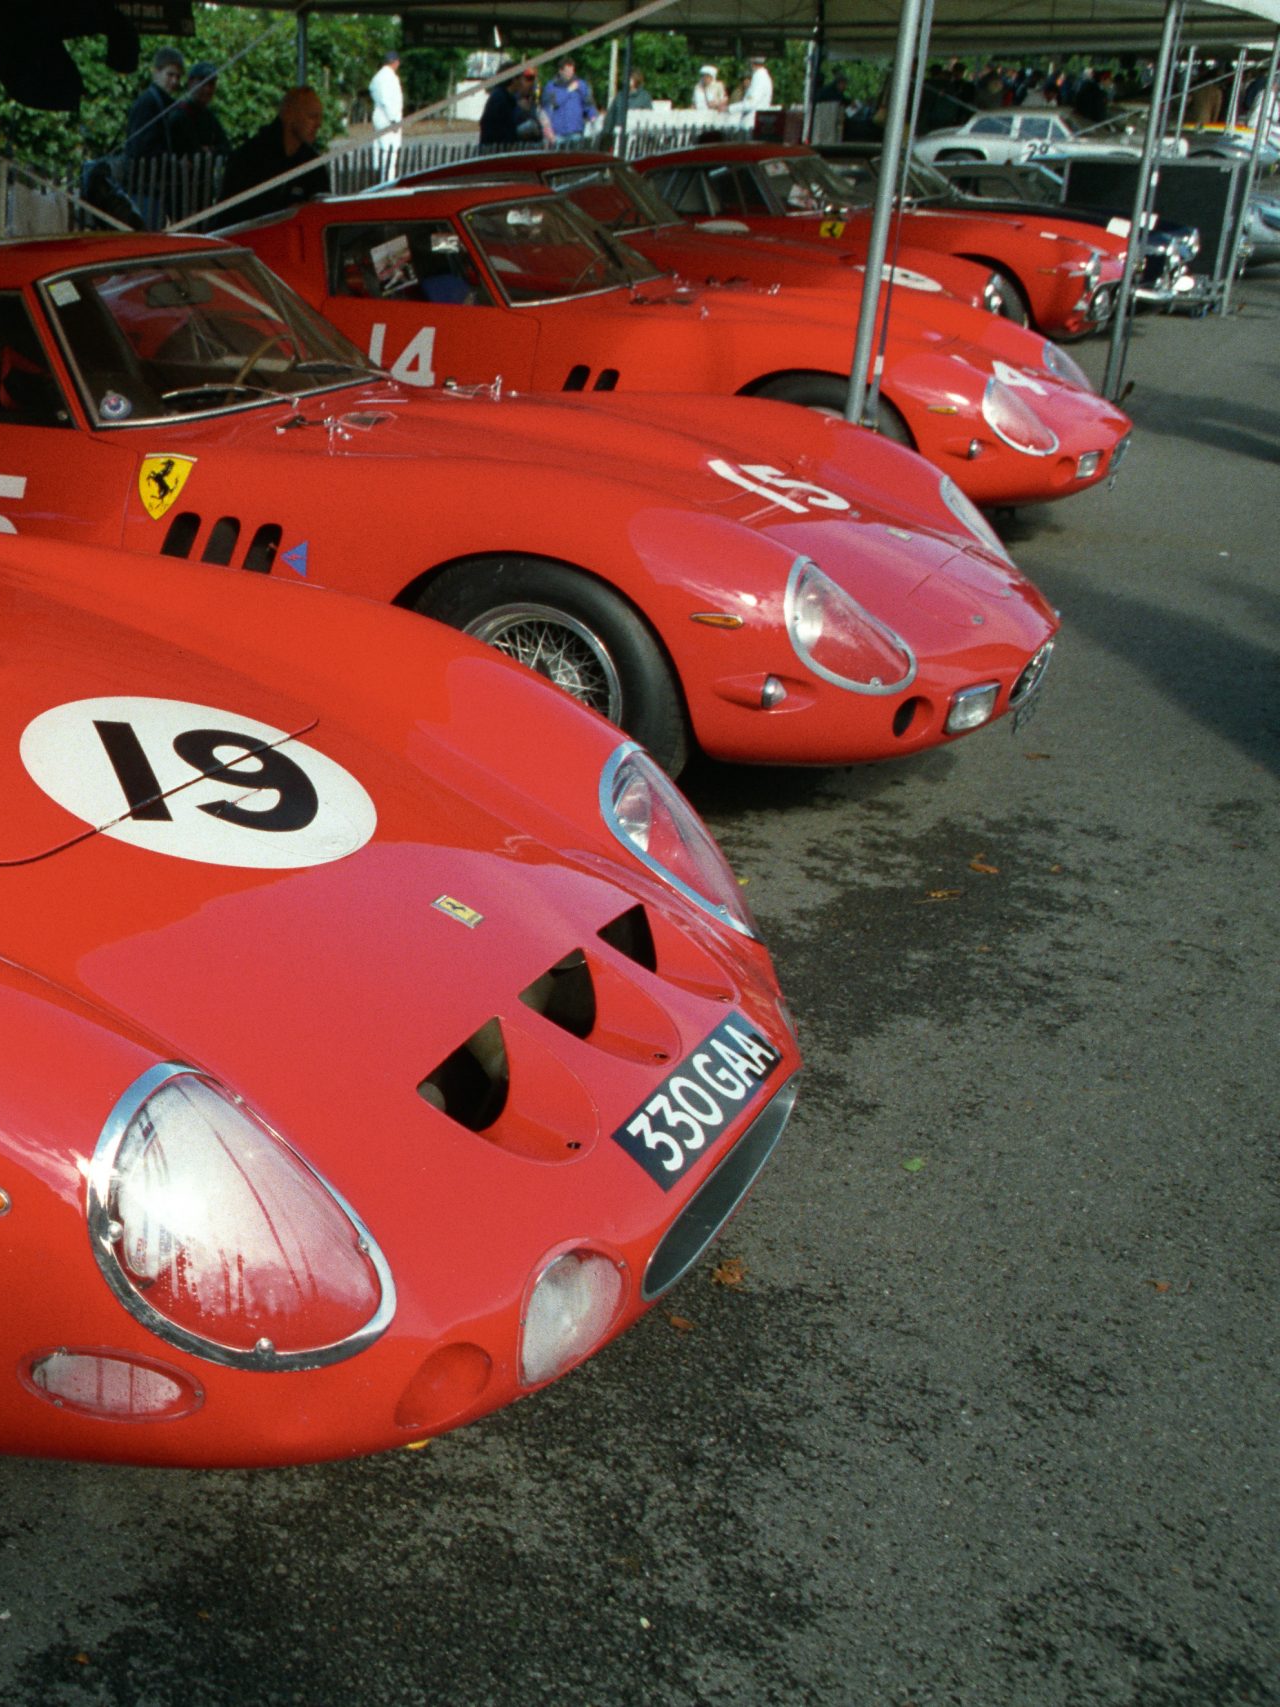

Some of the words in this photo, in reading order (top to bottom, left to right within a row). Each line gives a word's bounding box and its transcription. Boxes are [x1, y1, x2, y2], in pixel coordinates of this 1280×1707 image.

[368, 323, 436, 388] 14
[707, 459, 851, 513] 15
[92, 720, 319, 832] 19
[626, 1076, 724, 1172] 330
[692, 1024, 775, 1100] GAA
